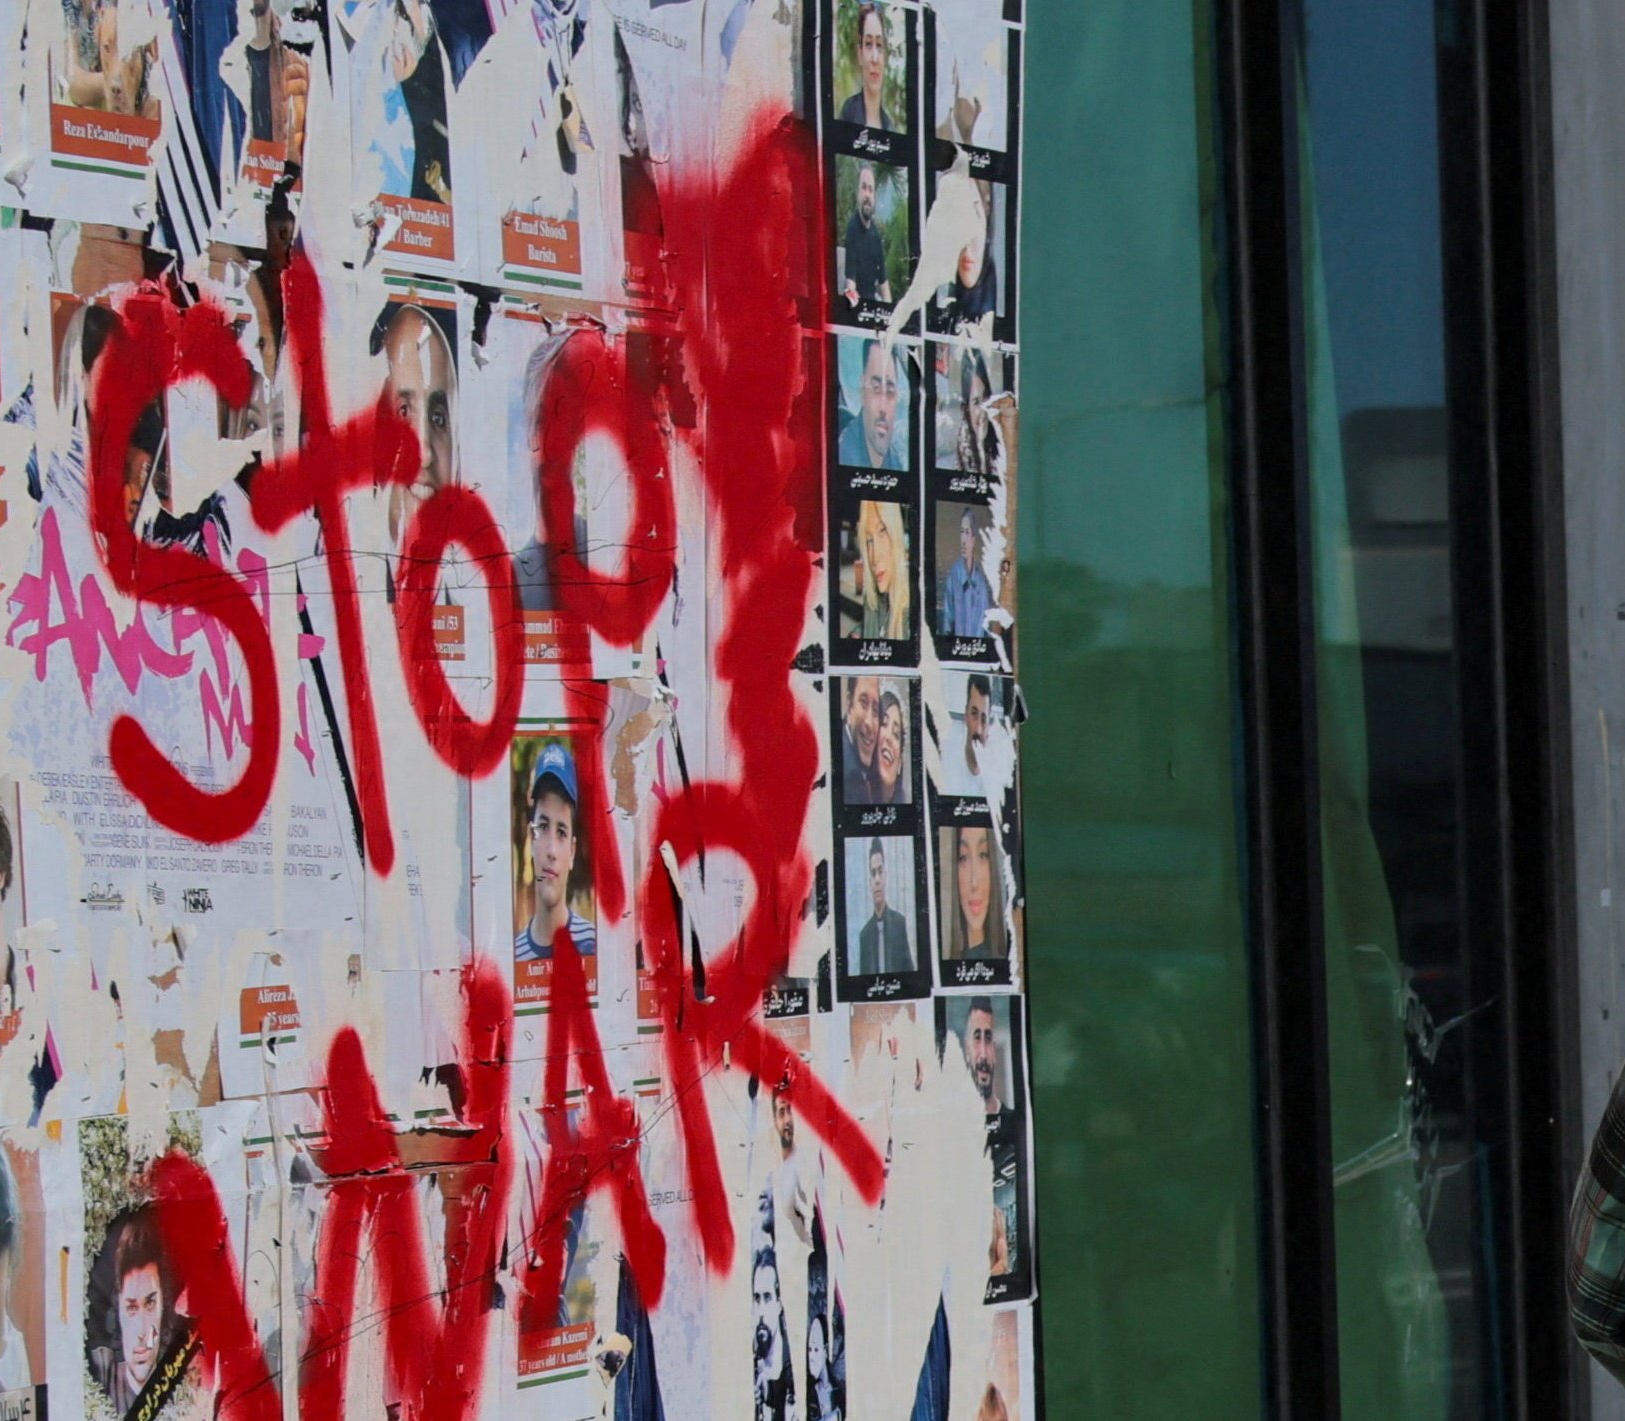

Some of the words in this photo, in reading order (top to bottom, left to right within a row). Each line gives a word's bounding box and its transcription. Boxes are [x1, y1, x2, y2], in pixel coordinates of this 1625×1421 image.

[63, 119, 86, 138] Reza
[259, 156, 285, 172] Soltan
[403, 228, 433, 248] Barber
[515, 216, 539, 236] Emad
[539, 219, 568, 241] Shoosh
[527, 243, 557, 264] Barista
[256, 988, 288, 1005] Alireza
[562, 1327, 589, 1345] Kazemi
